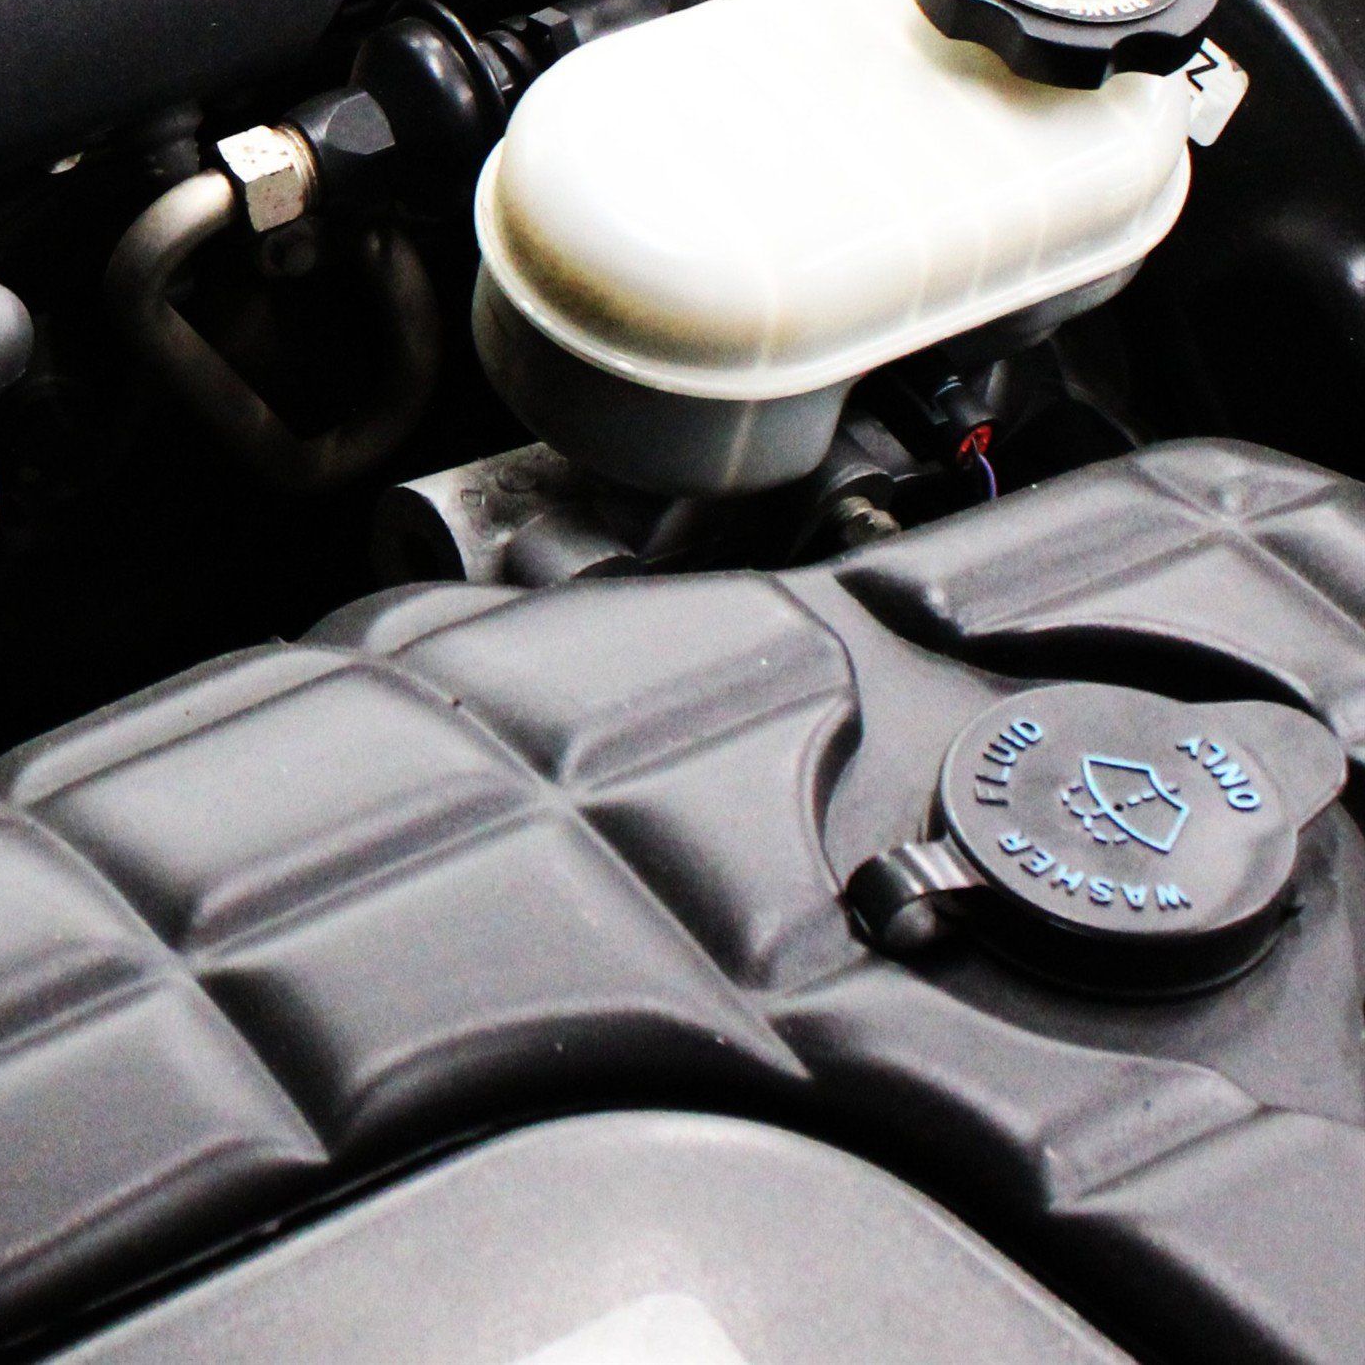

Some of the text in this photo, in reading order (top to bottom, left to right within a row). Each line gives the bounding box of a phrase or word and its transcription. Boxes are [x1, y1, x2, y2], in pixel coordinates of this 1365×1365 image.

[975, 716, 1263, 912] WASHER FLUID ONLY
